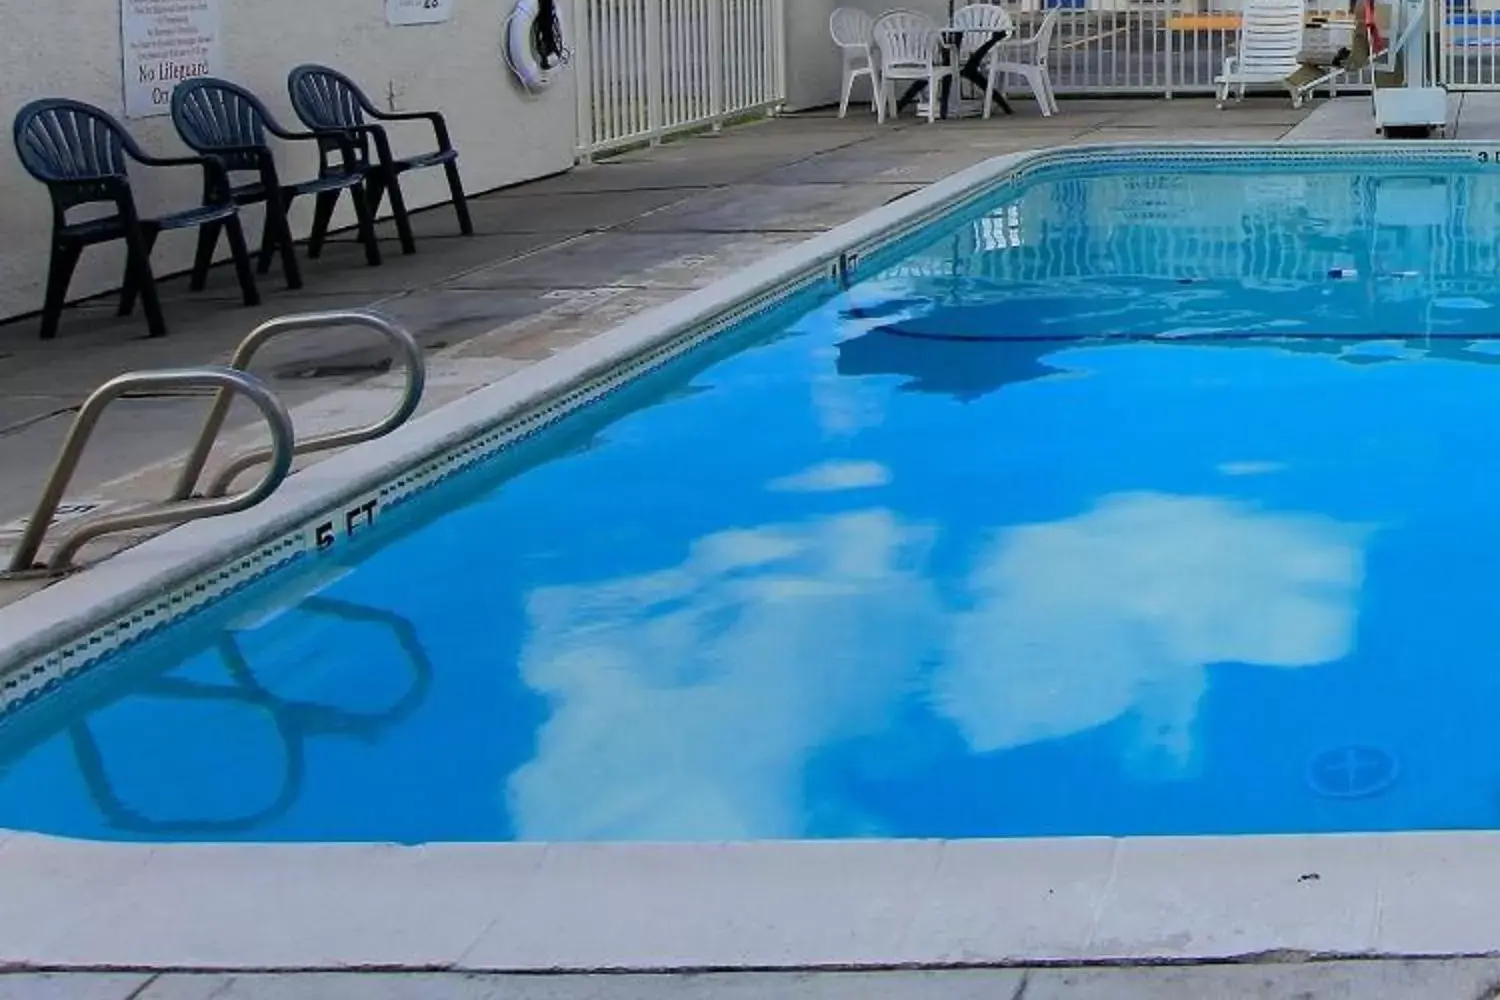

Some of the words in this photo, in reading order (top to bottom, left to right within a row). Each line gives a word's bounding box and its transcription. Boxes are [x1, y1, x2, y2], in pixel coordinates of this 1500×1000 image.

[139, 64, 155, 83] No
[159, 60, 209, 81] Lifeguard
[1478, 151, 1488, 163] 3
[316, 520, 335, 549] 5
[346, 498, 377, 537] FT
